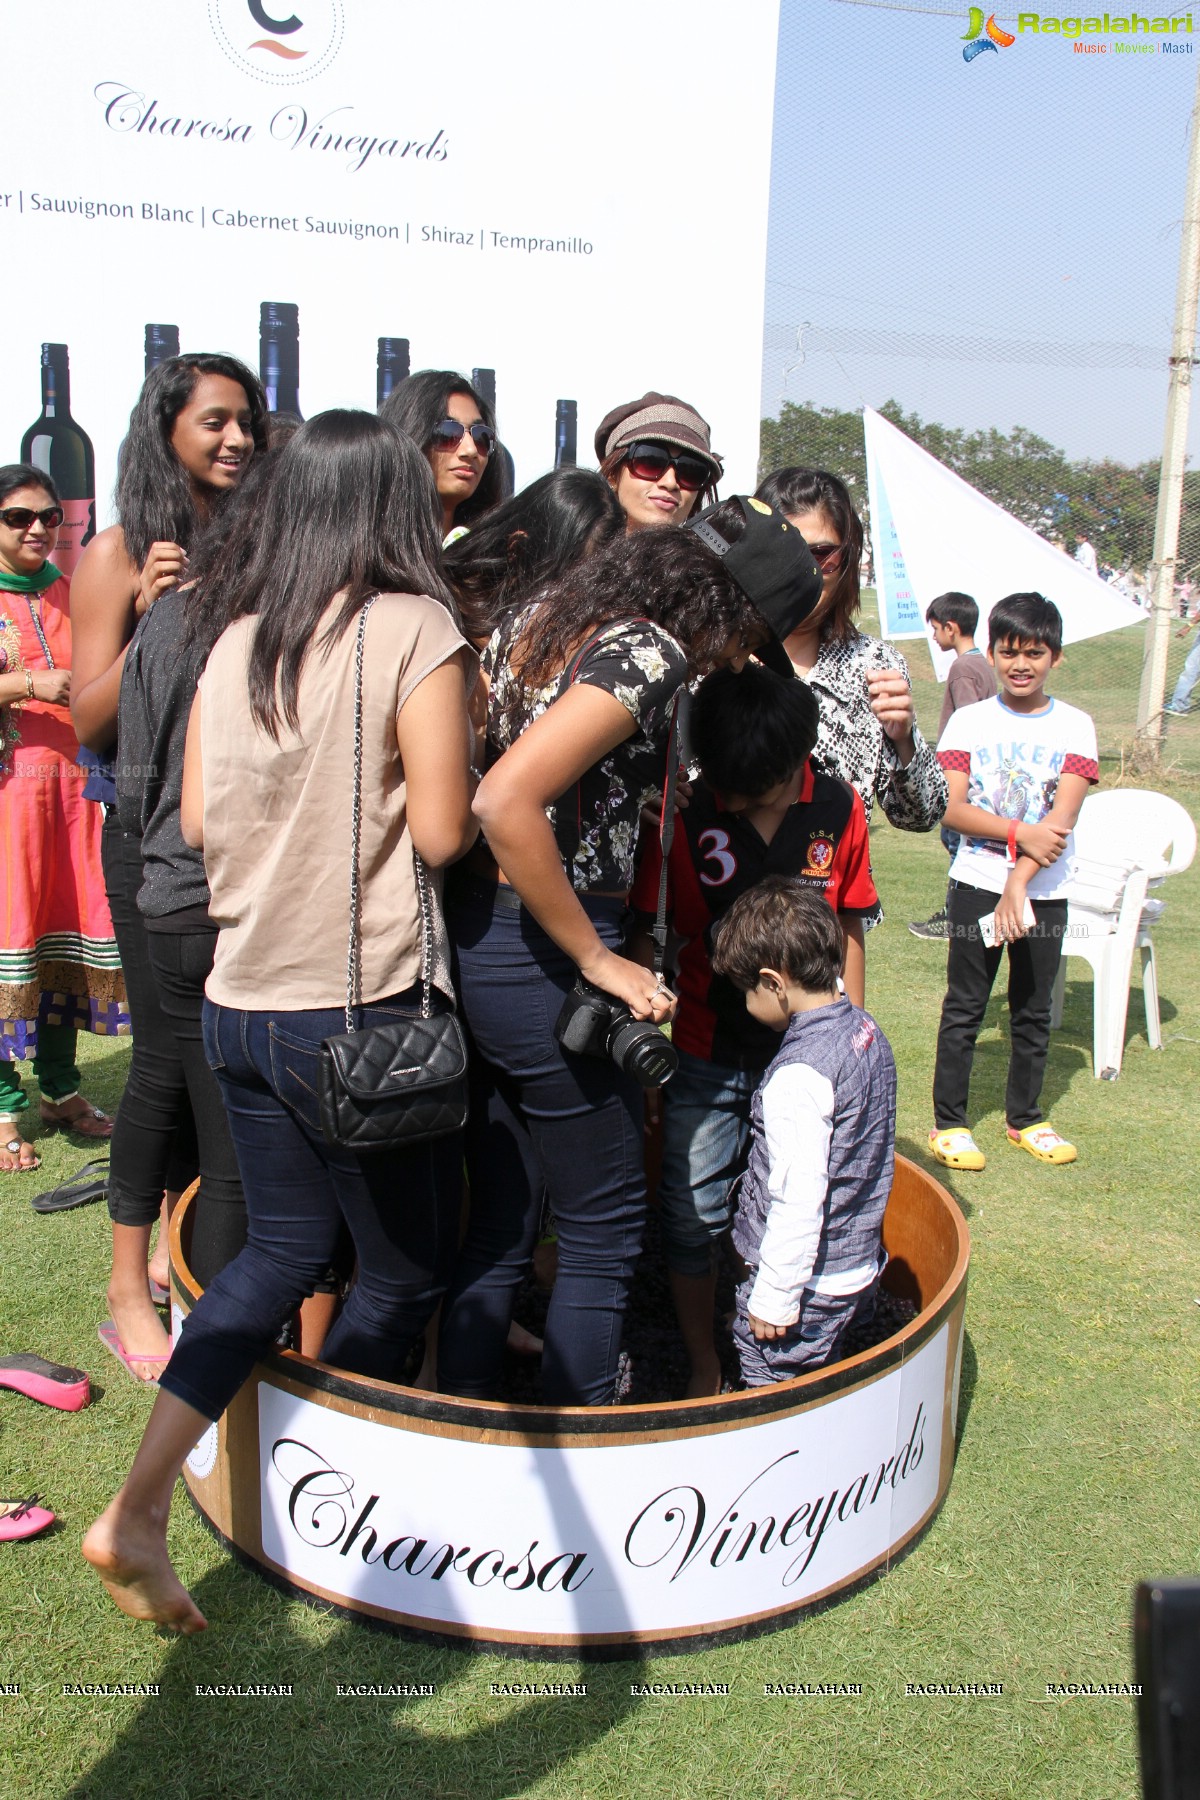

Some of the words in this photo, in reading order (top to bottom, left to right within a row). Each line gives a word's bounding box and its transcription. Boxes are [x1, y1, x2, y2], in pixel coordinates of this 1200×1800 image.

[94, 81, 254, 144] Charosa
[269, 104, 449, 173] Vineyards
[31, 193, 134, 220] Sauvignon
[142, 203, 194, 224] Blanc
[212, 209, 299, 231] Cabernet
[305, 217, 399, 240] Sauvignon
[421, 225, 474, 245] Shiraz
[490, 231, 593, 255] Tempranillo
[975, 741, 1063, 774] BIKER
[698, 828, 737, 886] 3
[272, 1438, 594, 1592] Charosa
[624, 1402, 926, 1587] Vineyards
